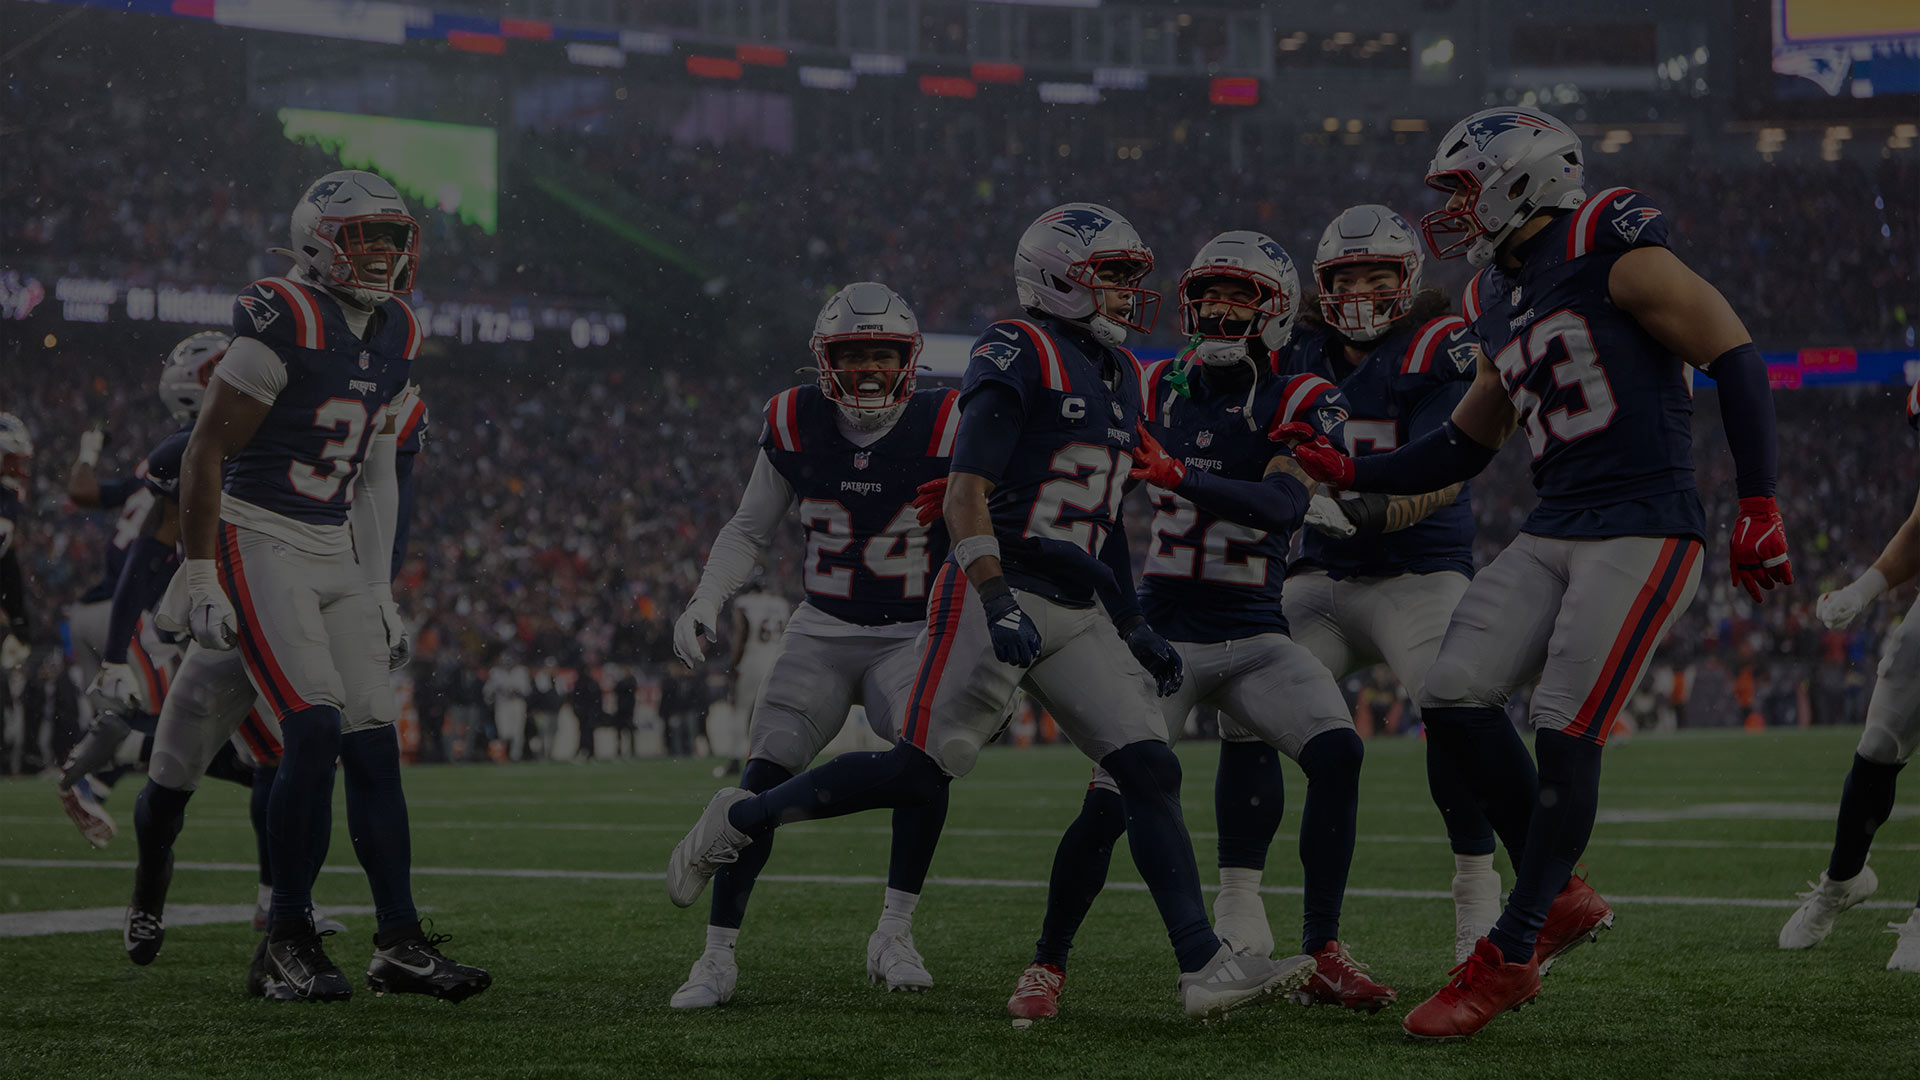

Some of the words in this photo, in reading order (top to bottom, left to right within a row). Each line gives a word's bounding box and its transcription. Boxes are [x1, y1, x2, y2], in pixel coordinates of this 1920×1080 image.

[1061, 397, 1085, 419] C
[1185, 456, 1223, 471] PATRIOTS
[840, 481, 882, 493] PATRIOTS
[1143, 482, 1269, 588] 22
[799, 496, 932, 600] 24
